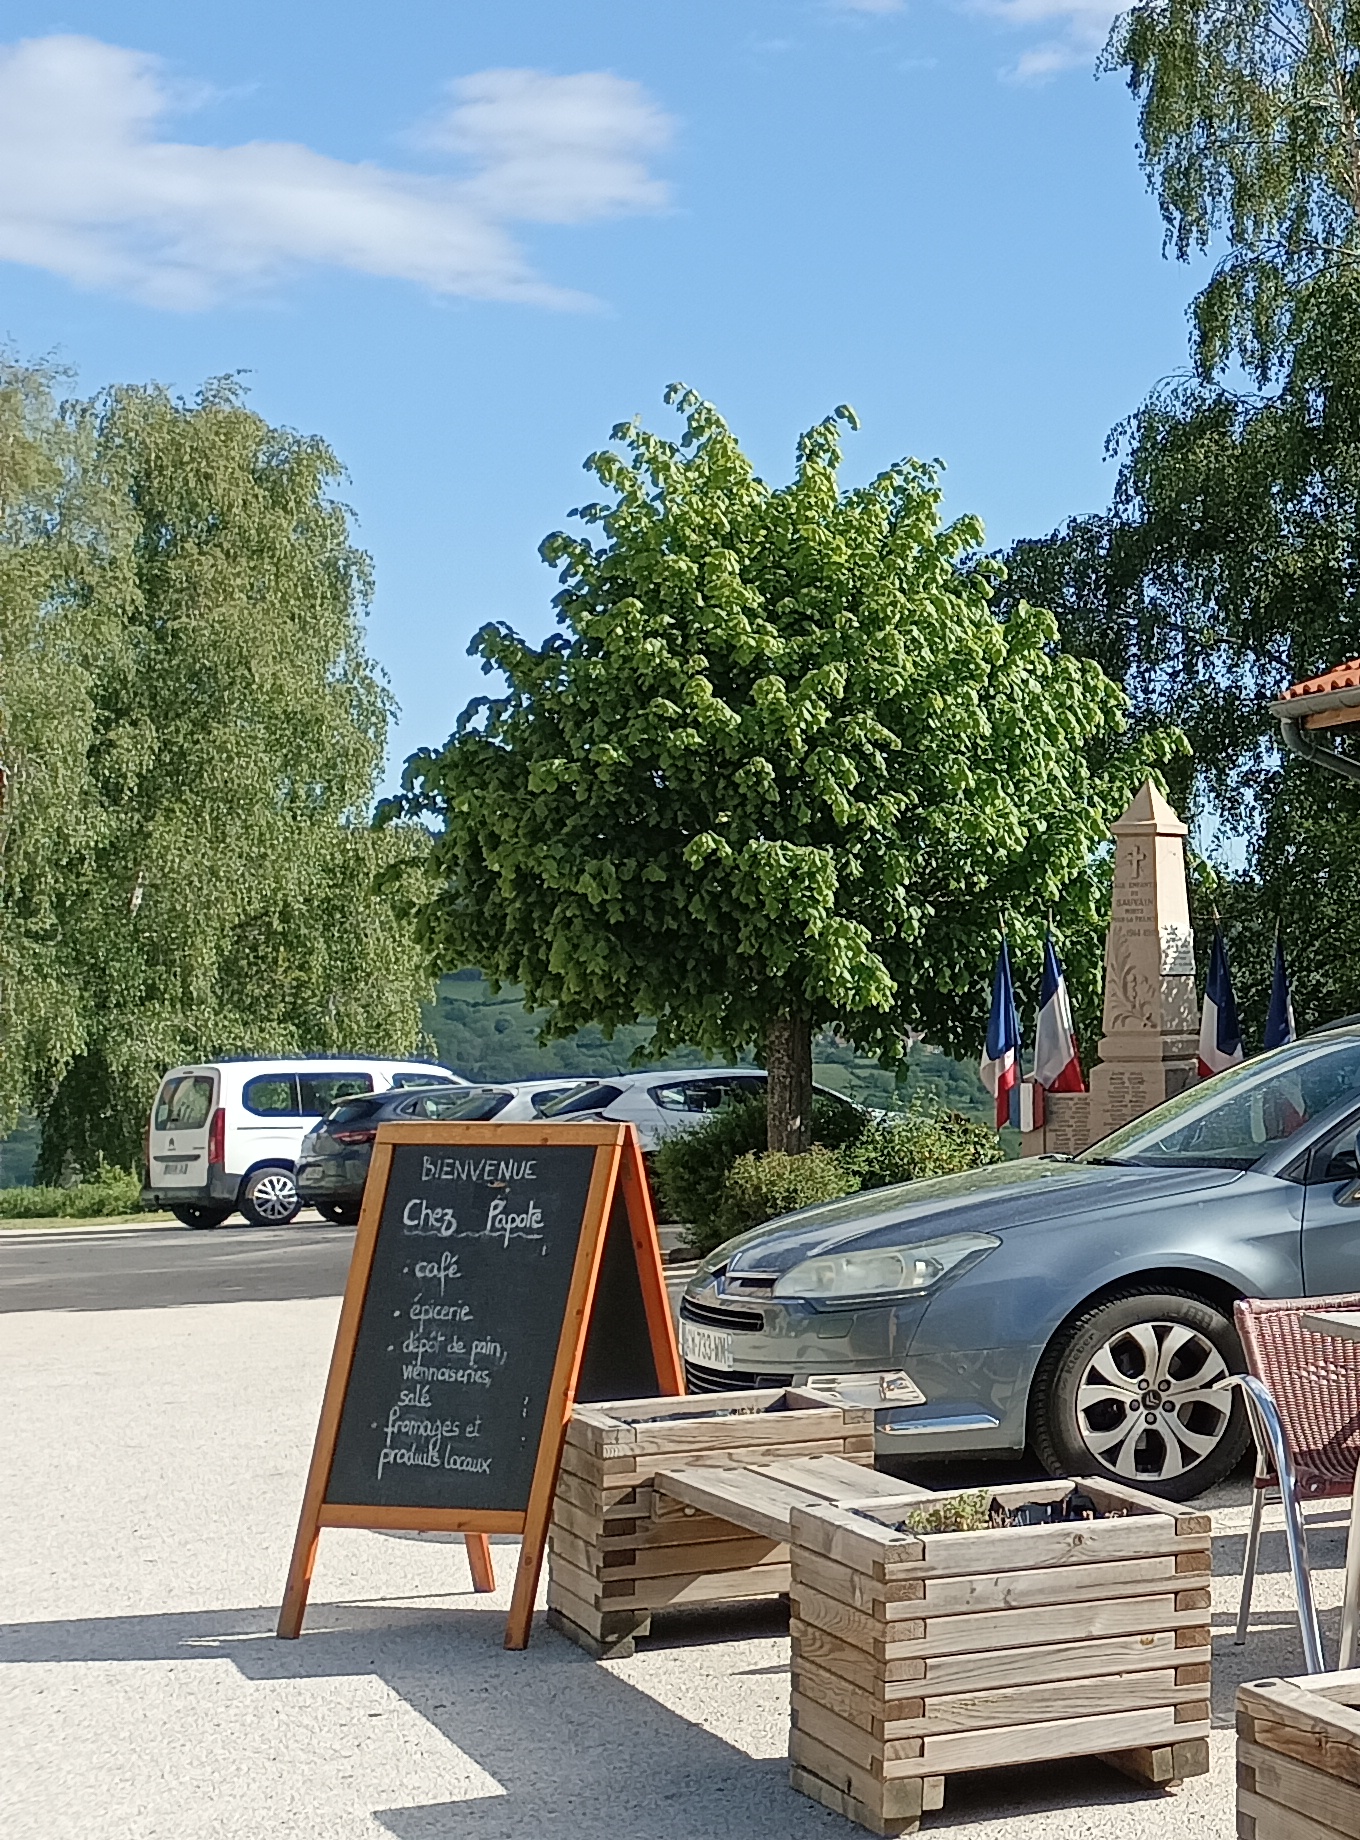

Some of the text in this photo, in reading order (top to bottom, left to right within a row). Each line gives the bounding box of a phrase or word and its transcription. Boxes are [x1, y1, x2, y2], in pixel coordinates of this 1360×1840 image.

[421, 1155, 538, 1182] BIENVENUE
[402, 1198, 458, 1236] Chez
[414, 1250, 463, 1297] café
[409, 1292, 474, 1333] épicerie
[402, 1330, 446, 1366] dépôt
[446, 1334, 467, 1353] de
[397, 1383, 432, 1407] salé
[383, 1405, 482, 1450] fromages et
[377, 1442, 493, 1481] produits locaux
